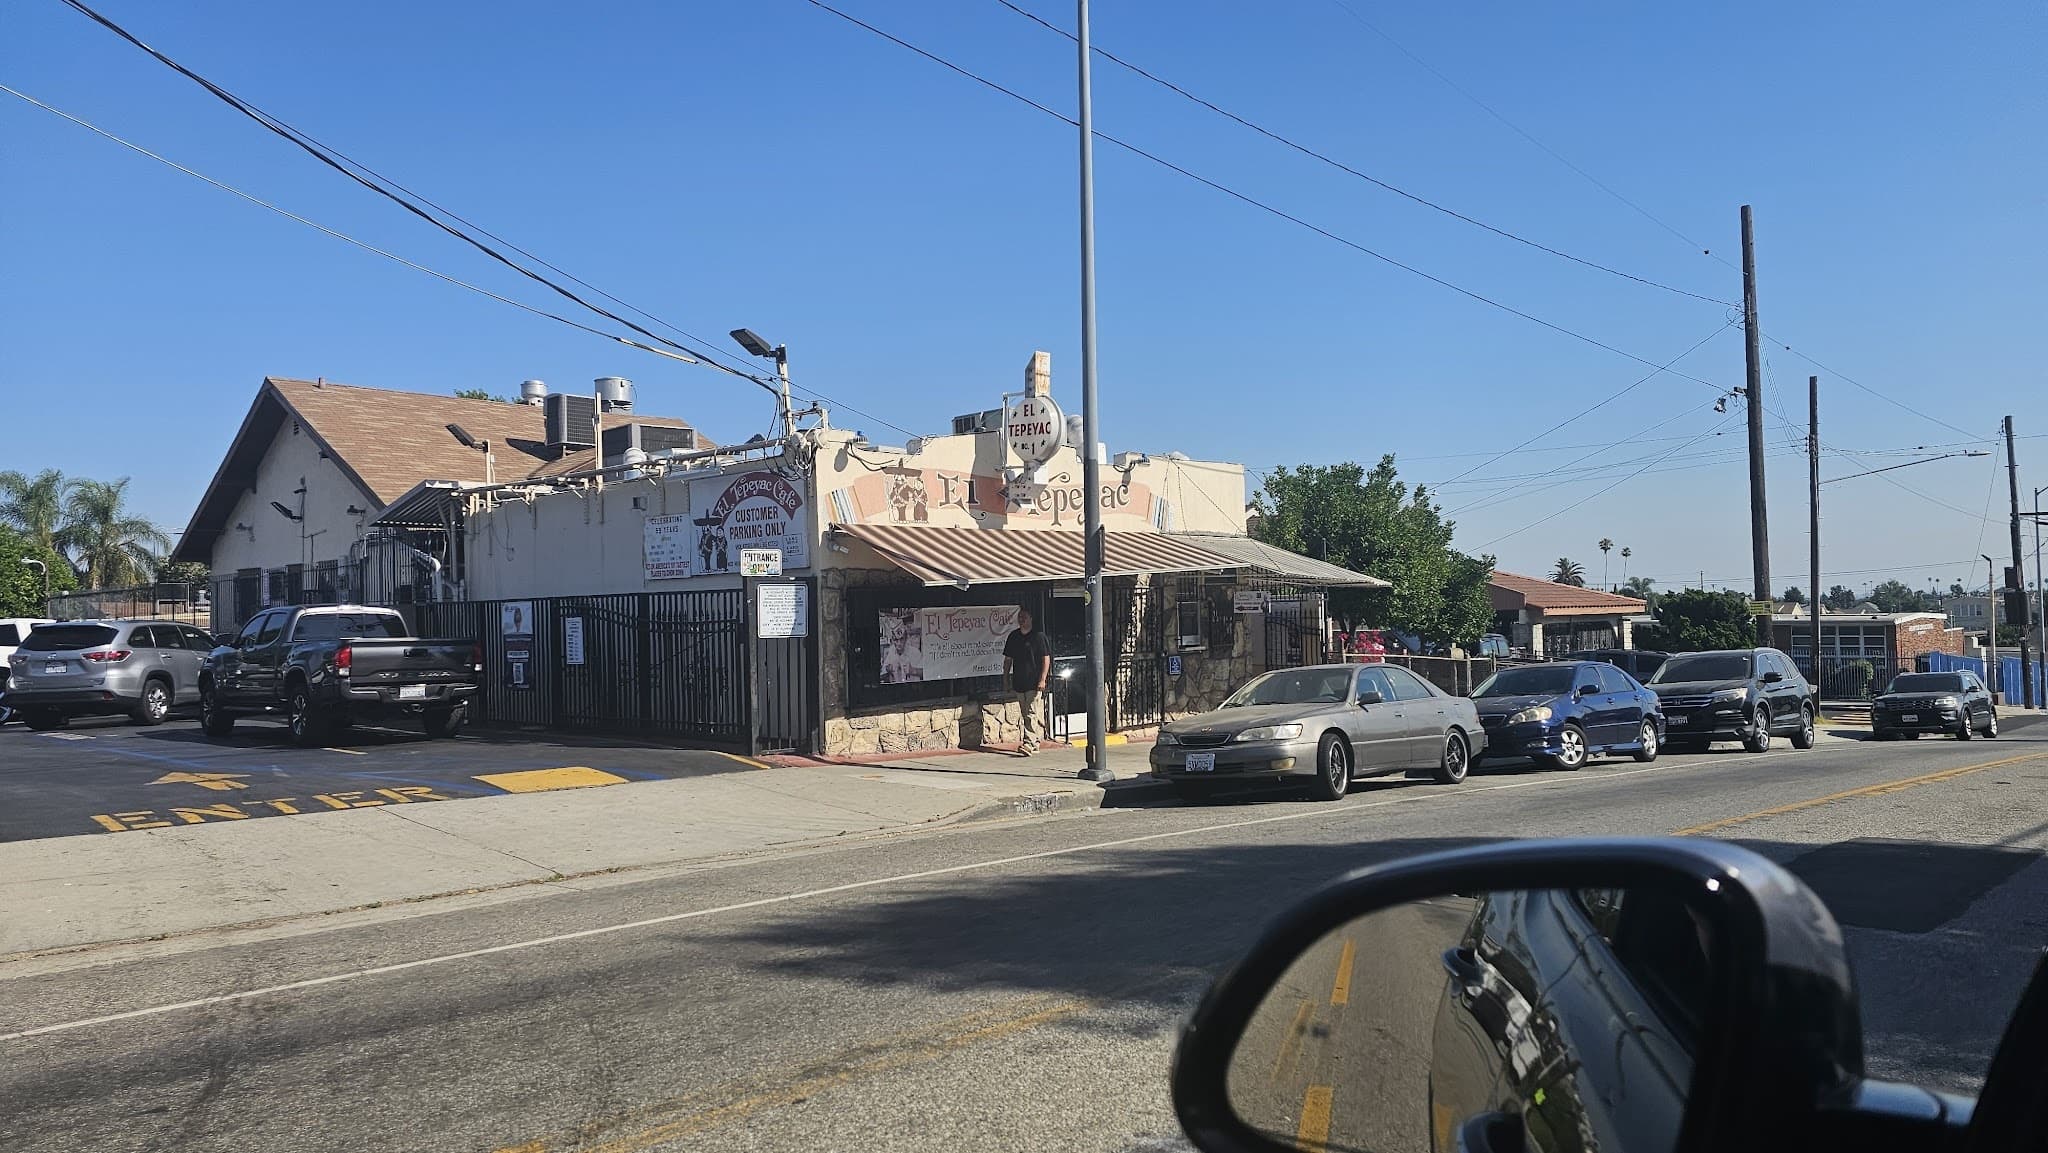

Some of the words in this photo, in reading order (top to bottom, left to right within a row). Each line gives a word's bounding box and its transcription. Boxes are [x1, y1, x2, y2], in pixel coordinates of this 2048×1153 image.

[1023, 403, 1035, 417] EL
[1008, 421, 1051, 437] TEPEYAC
[714, 497, 735, 518] El
[729, 477, 773, 501] Tepeyac
[937, 471, 987, 521] El
[1027, 472, 1130, 527] epeac
[735, 505, 779, 523] CUSTOMER
[729, 525, 763, 540] PARKING
[765, 521, 786, 537] ONLY
[744, 552, 779, 562] ENTRANCE
[752, 563, 770, 574] ONLY
[925, 612, 949, 640] El
[945, 608, 986, 632] Tepeyac
[90, 786, 450, 832] ENTER
